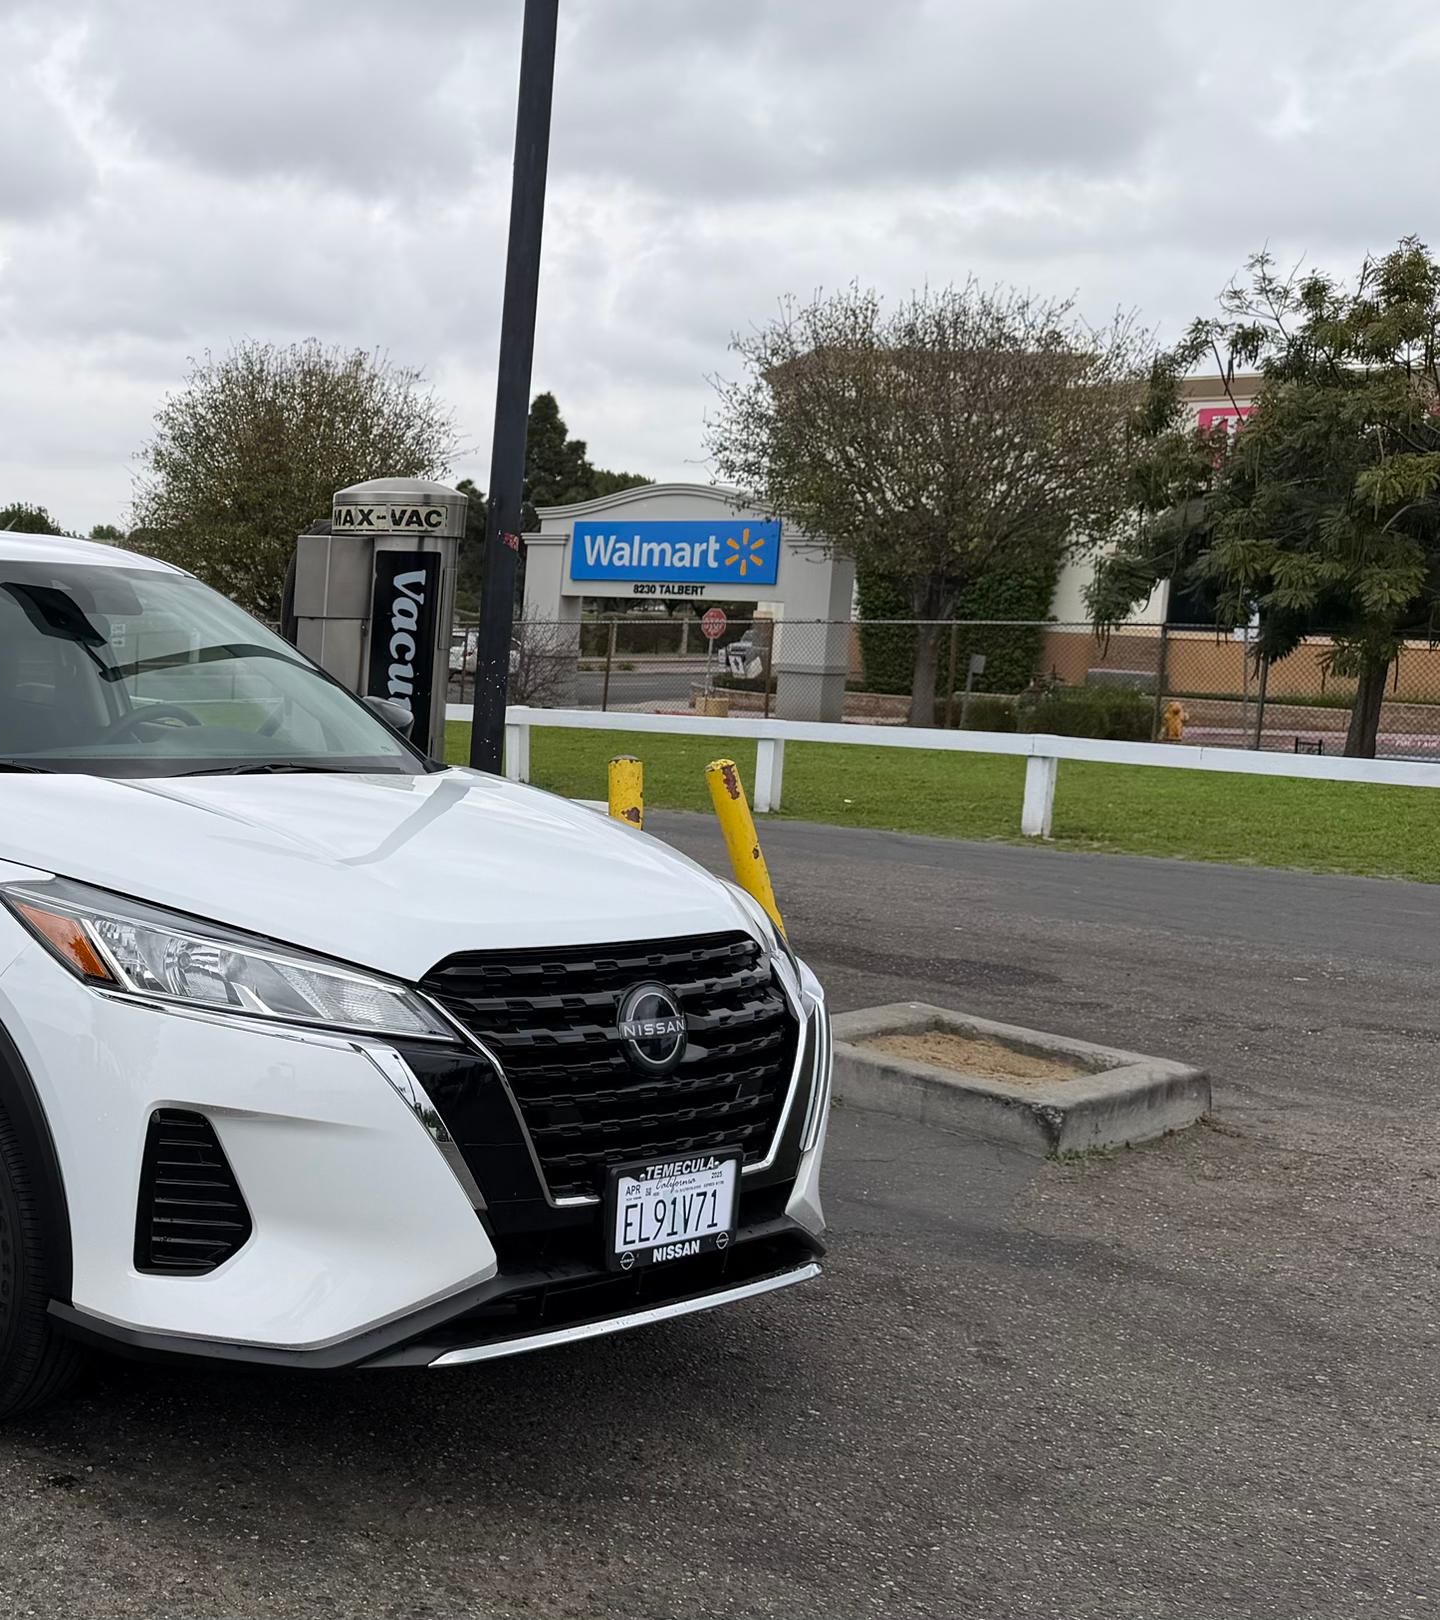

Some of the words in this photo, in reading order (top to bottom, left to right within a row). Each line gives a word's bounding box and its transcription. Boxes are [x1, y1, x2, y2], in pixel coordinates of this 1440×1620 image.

[334, 508, 443, 528] MAX-VAC
[584, 534, 720, 569] Walmart
[633, 584, 656, 595] 8230
[659, 584, 706, 597] TALBERT
[388, 569, 427, 718] Vacu
[623, 1019, 685, 1037] NISSAN
[645, 1156, 715, 1180] TEMECULA
[625, 1184, 641, 1197] APR
[655, 1176, 696, 1193] California
[622, 1188, 718, 1246] EL91V71
[652, 1239, 701, 1263] NISSAN
